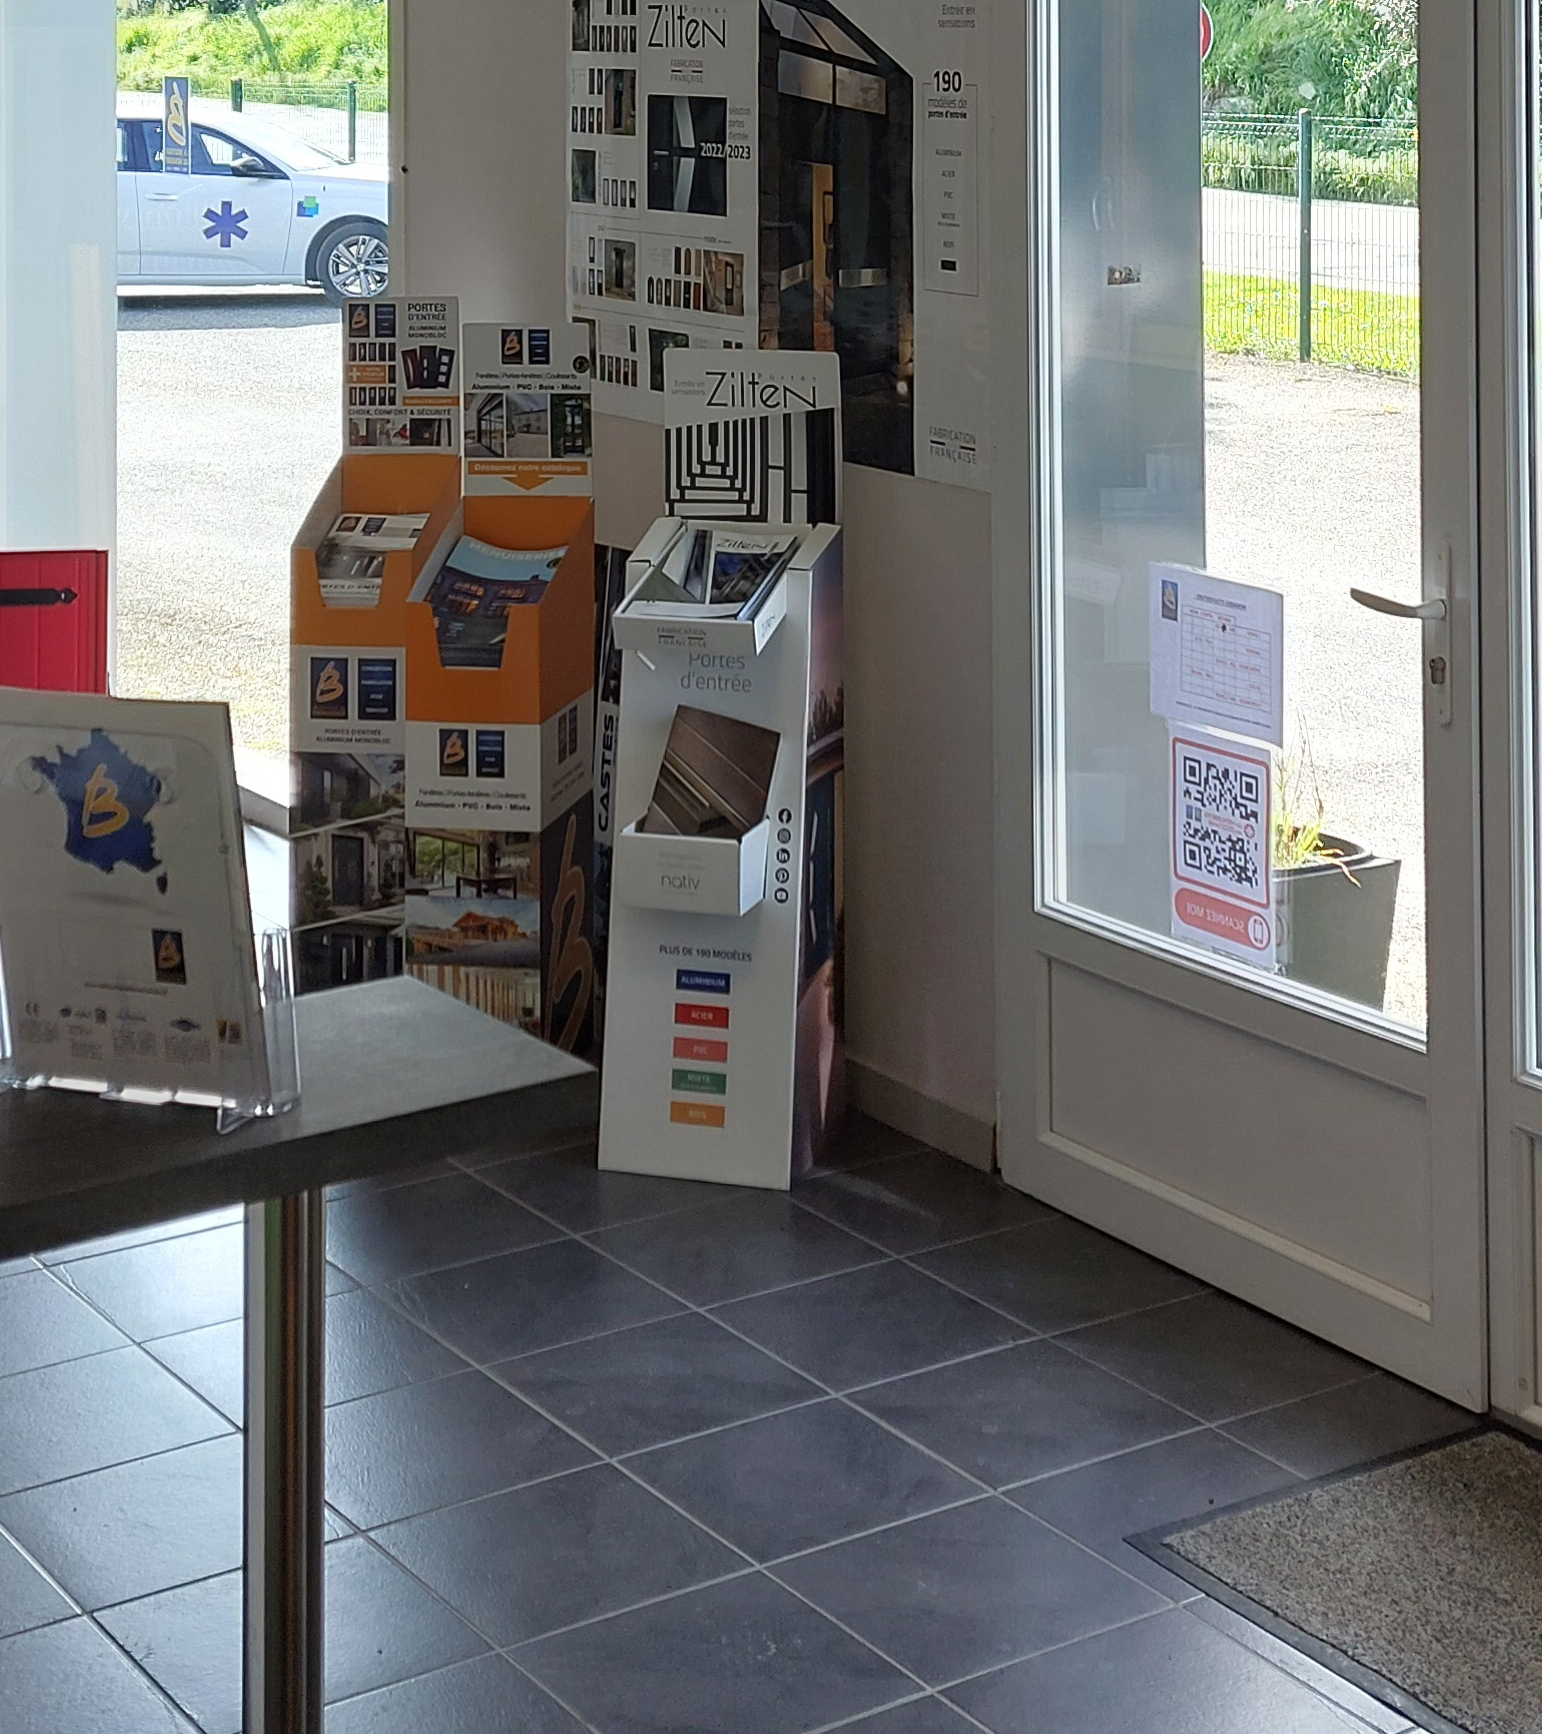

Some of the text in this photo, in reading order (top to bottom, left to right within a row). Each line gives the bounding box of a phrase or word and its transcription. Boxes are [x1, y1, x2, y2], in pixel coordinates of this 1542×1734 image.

[966, 7, 975, 15] en
[933, 70, 962, 92] 190
[927, 96, 967, 108] modèles de
[700, 142, 751, 159] 2022/2023
[407, 303, 446, 312] PORTES
[408, 312, 447, 321] D'ENTRÉE
[374, 408, 407, 416] CONFORT
[929, 426, 976, 445] FABRICATION
[930, 446, 977, 465] FRANÇAISE
[689, 653, 746, 669] Portes
[680, 670, 752, 693] d'entrée
[598, 713, 615, 832] CASTES
[415, 800, 455, 808] Aluminium
[510, 803, 530, 811] Mixte
[661, 873, 700, 890] nativ
[659, 944, 752, 962] PLUS DE 190 MODÈLES
[680, 974, 725, 987] ALUMINIUM
